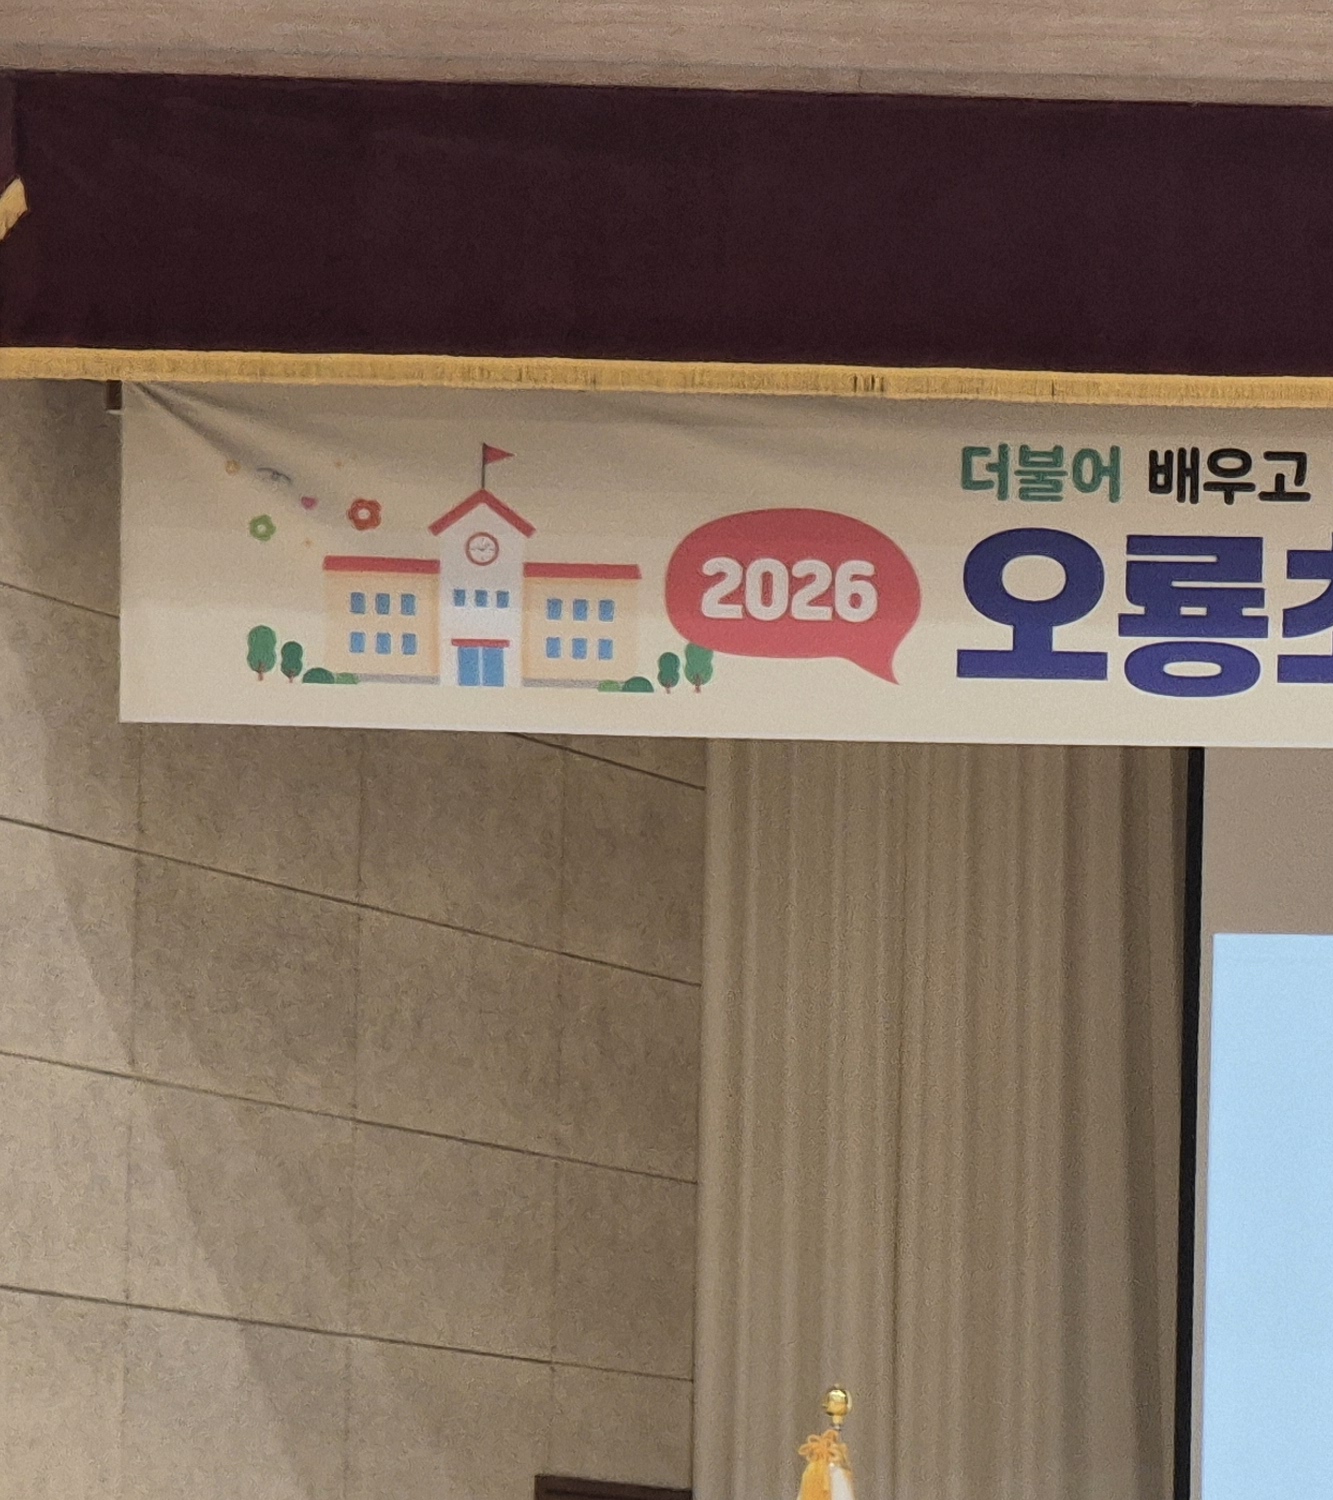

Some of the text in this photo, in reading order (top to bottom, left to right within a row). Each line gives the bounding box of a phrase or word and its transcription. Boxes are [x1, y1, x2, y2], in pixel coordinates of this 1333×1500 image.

[961, 443, 1121, 504] 더불어
[1148, 446, 1311, 506] 배우고
[701, 556, 878, 623] 2026
